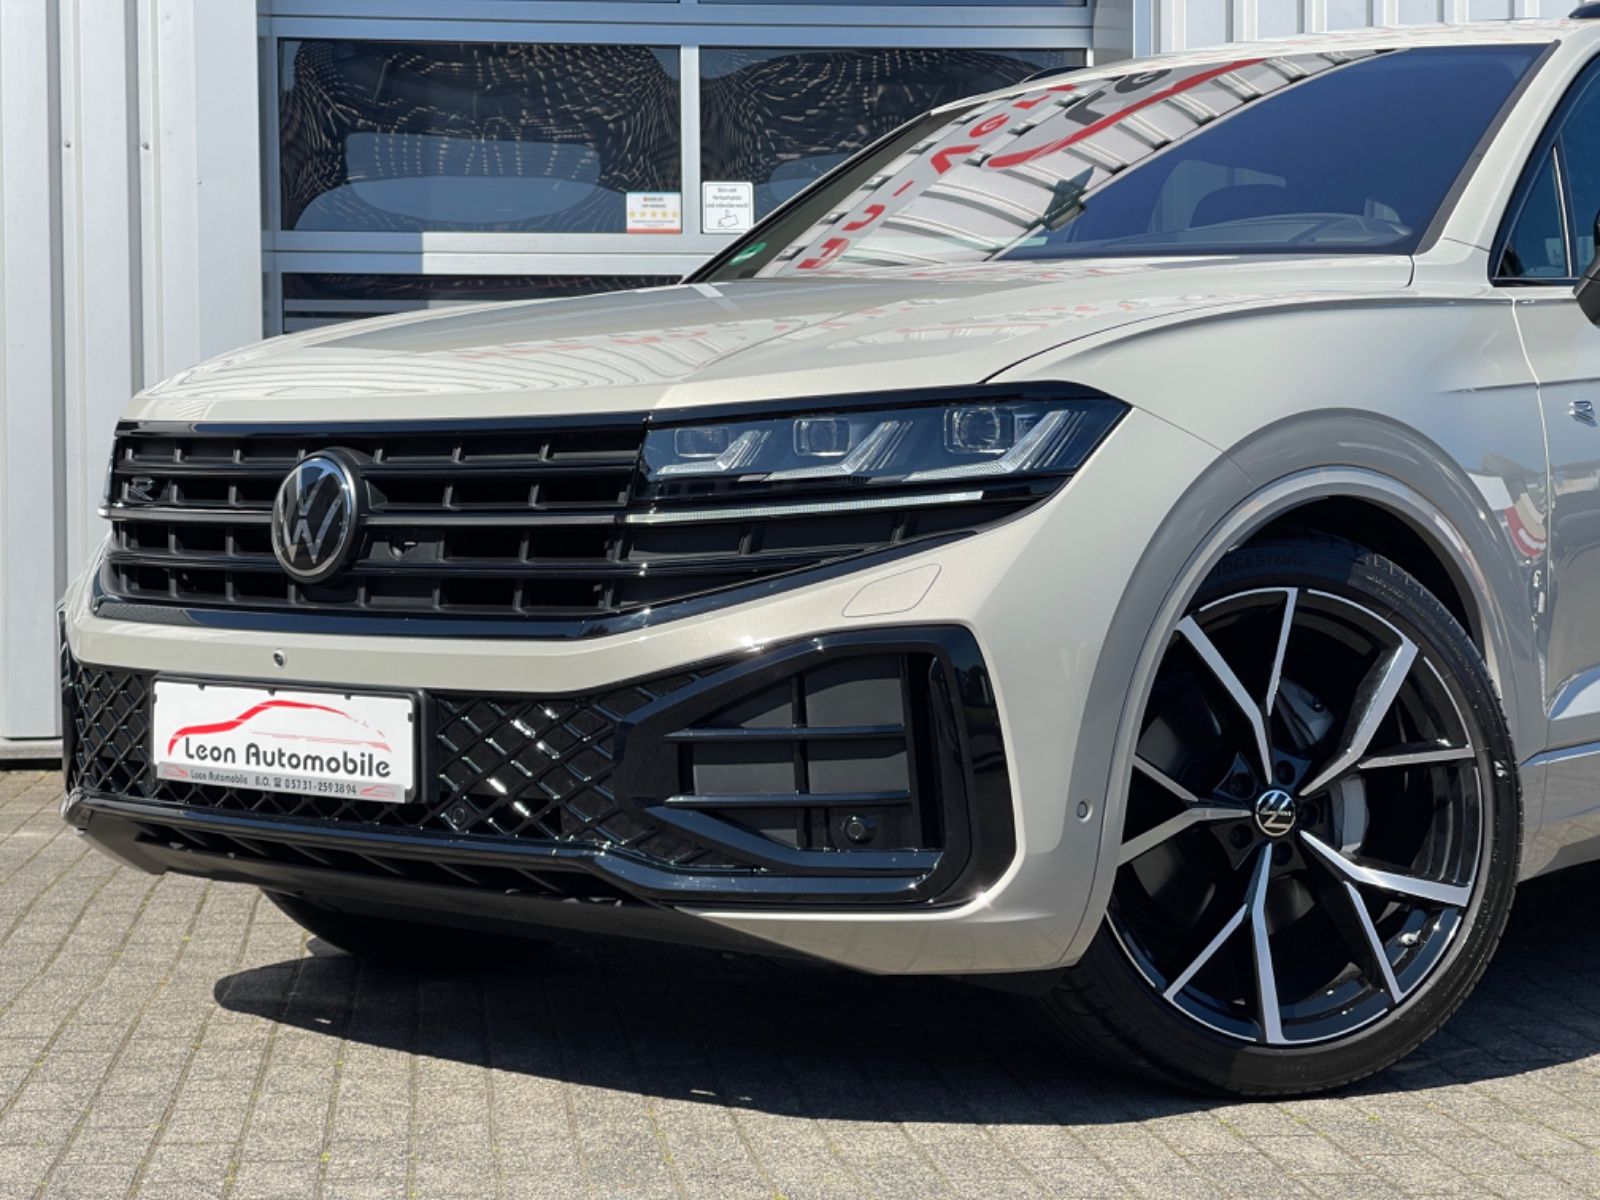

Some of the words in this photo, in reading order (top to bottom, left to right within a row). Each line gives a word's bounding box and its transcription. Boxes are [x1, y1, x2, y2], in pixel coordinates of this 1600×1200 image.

[185, 737, 236, 764] Leon
[246, 742, 391, 778] Automobile
[191, 769, 207, 780] Leon
[208, 771, 248, 785] Automobile
